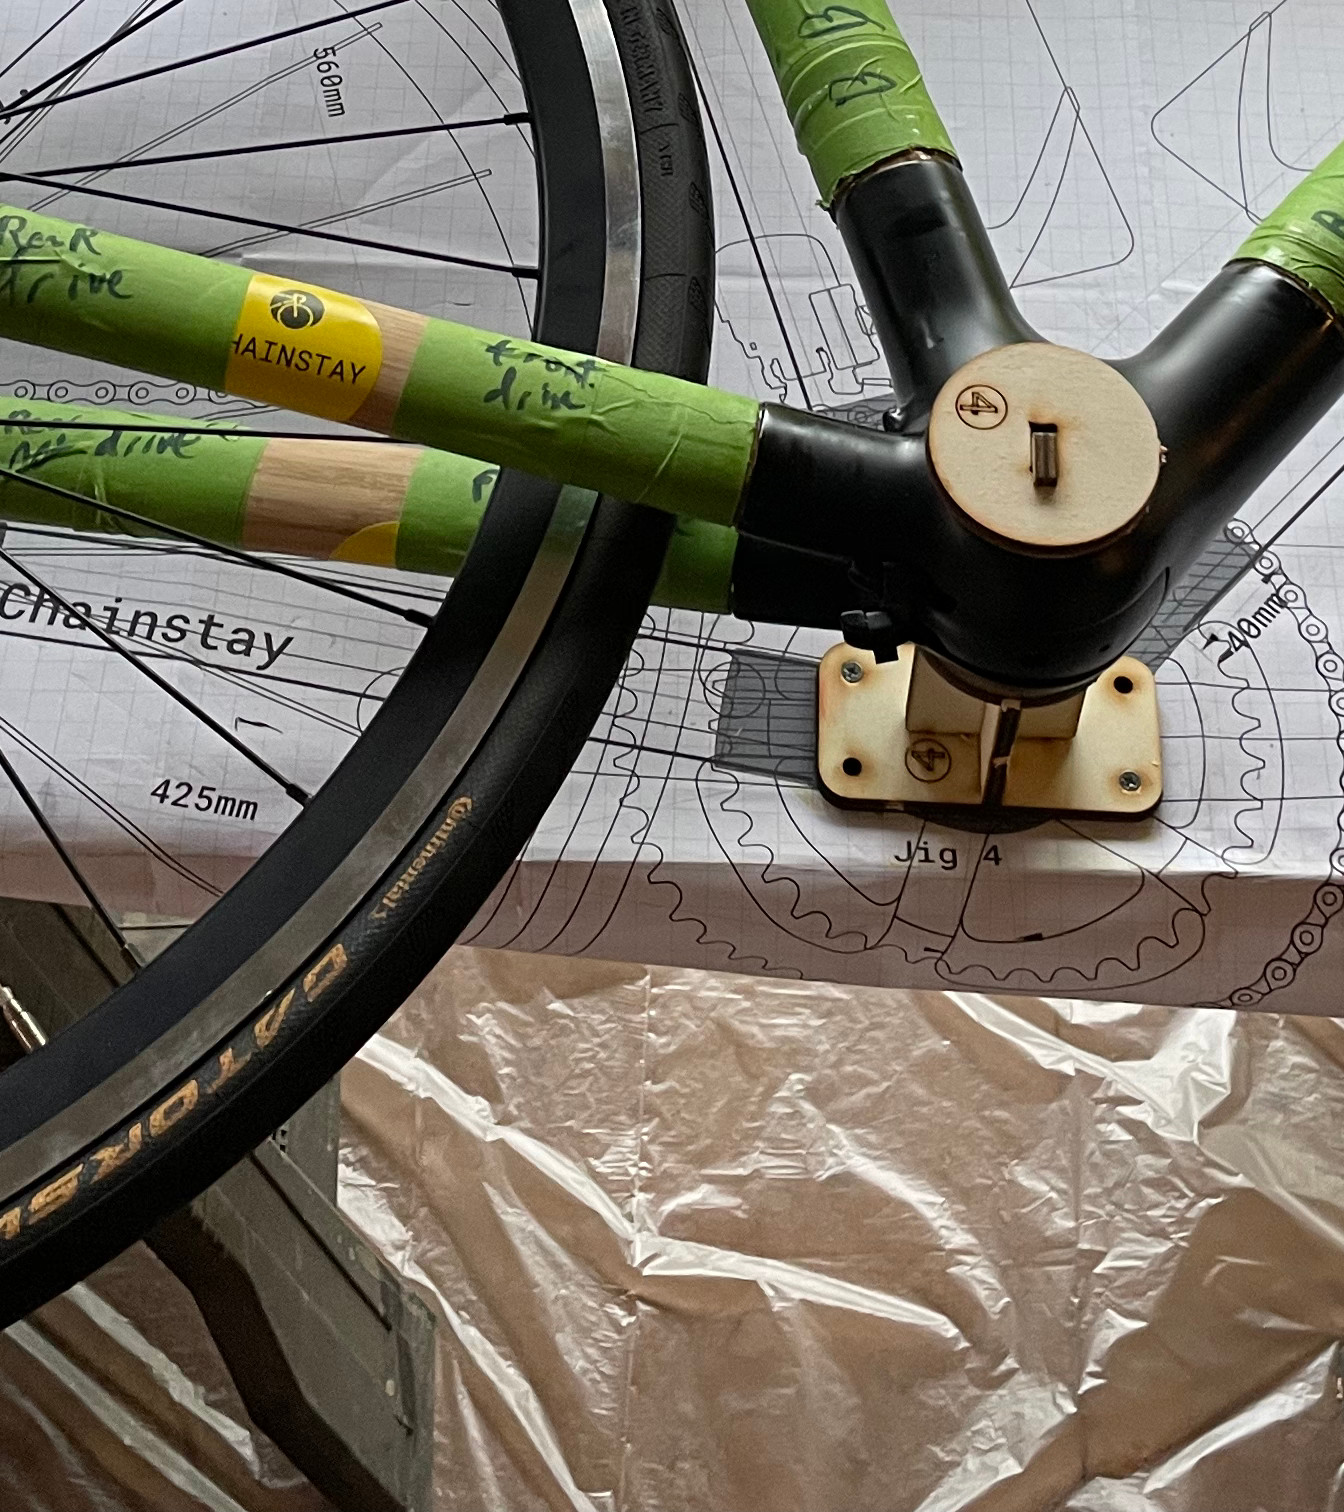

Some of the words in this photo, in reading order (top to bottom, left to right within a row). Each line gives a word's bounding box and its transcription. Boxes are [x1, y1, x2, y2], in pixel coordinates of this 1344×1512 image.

[312, 45, 348, 119] 560mm
[231, 333, 366, 385] HAINSTAY
[1224, 591, 1290, 663] 40mm
[149, 778, 260, 822] 425mm
[892, 839, 958, 870] Jig
[982, 843, 1003, 866] 4
